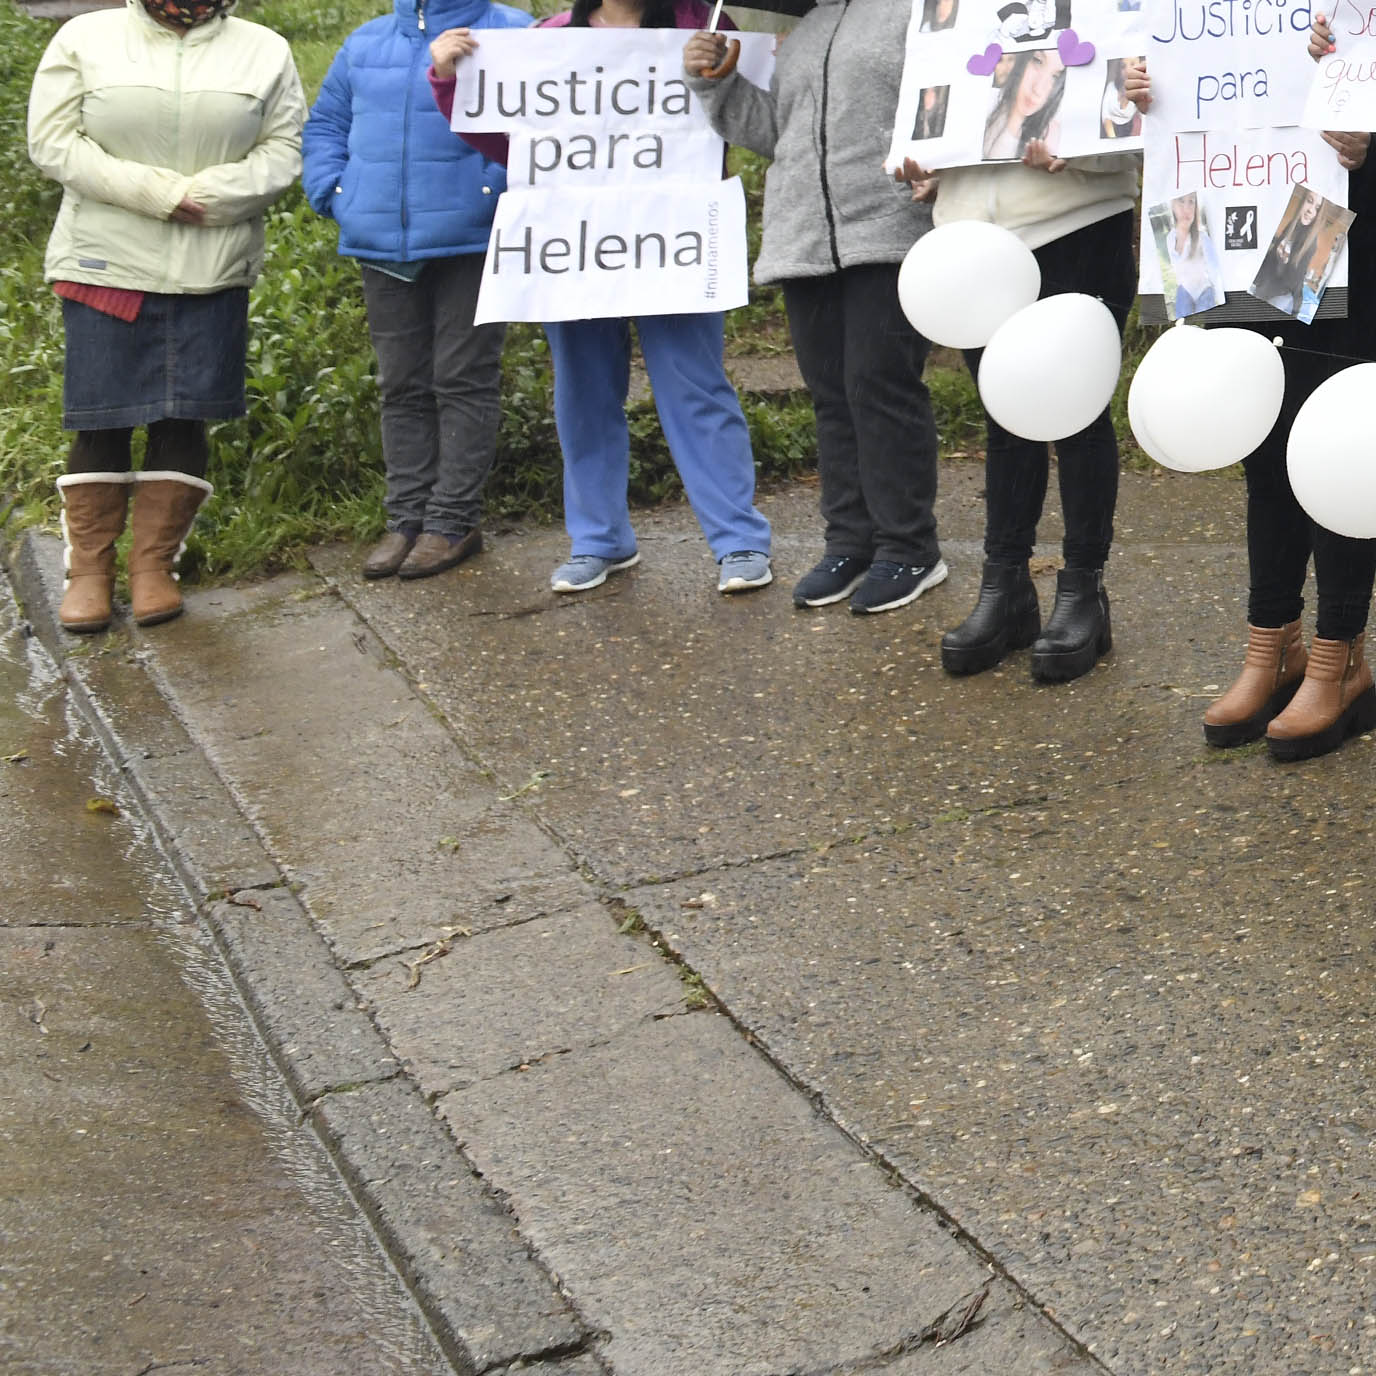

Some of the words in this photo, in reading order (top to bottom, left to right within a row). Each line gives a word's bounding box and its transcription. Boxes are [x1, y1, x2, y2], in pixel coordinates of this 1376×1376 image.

[464, 66, 691, 118] Justicia
[1196, 68, 1269, 120] para
[528, 133, 664, 186] para
[492, 220, 703, 274] Helena
